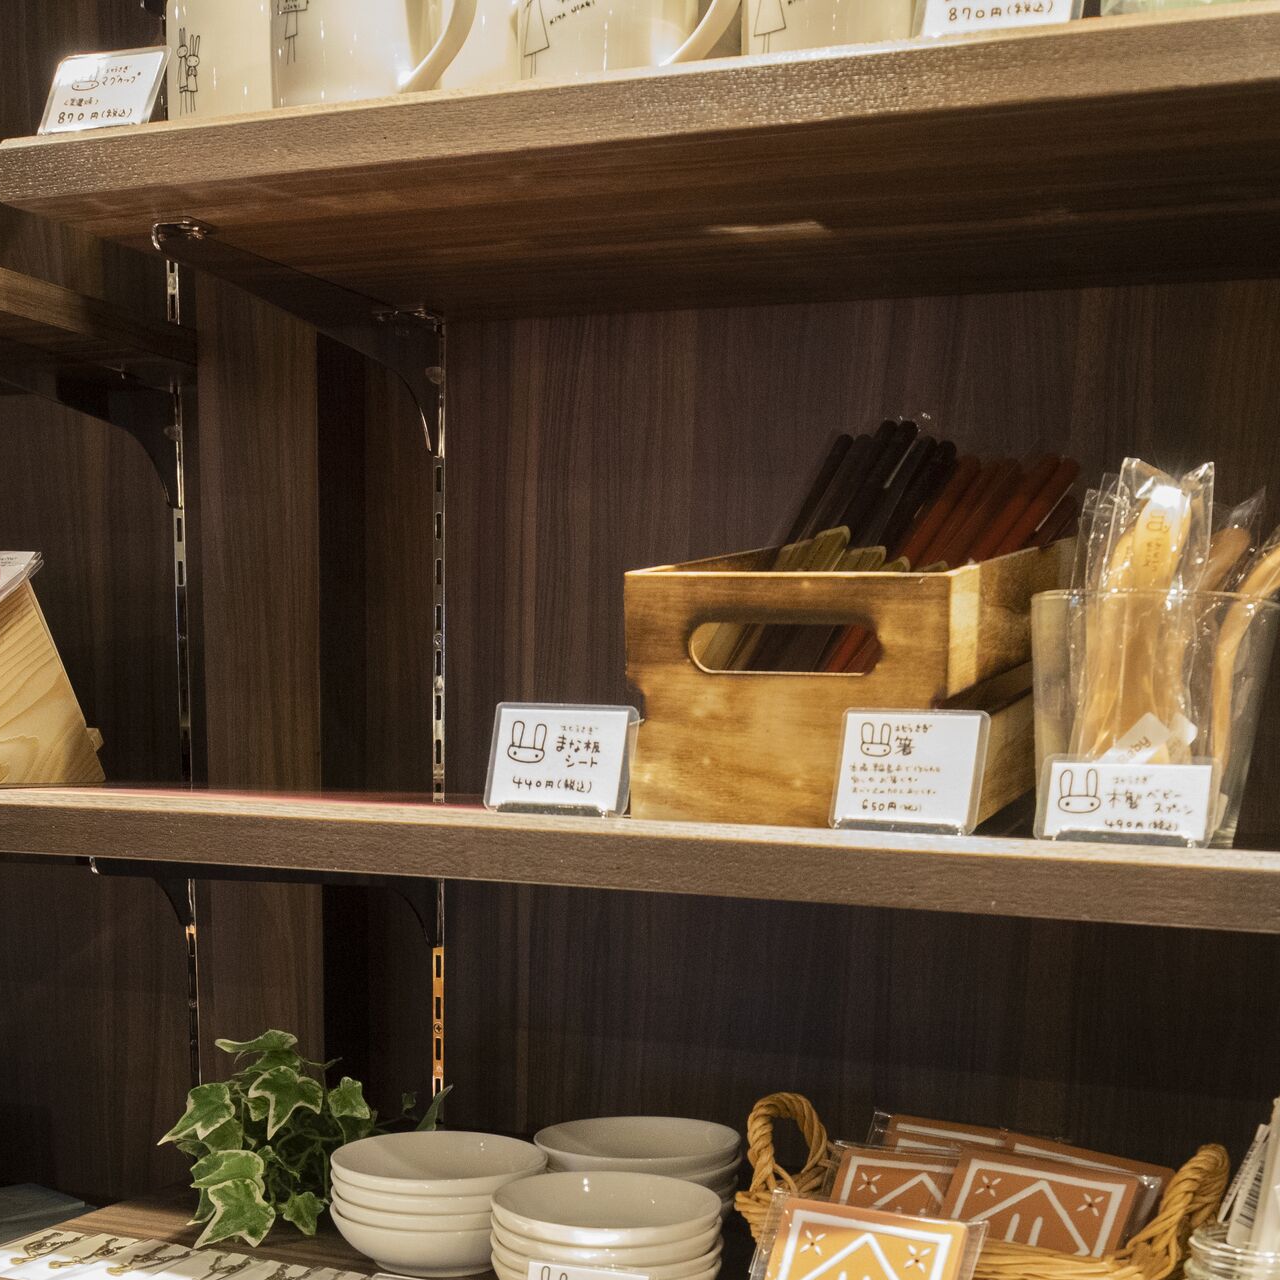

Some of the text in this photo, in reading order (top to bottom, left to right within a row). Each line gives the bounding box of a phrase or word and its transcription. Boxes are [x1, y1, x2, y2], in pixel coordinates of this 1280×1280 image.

[102, 71, 142, 86] マグカップ
[556, 735, 601, 753] まな板
[565, 755, 598, 768] シート
[512, 776, 593, 793] 440円(税込)
